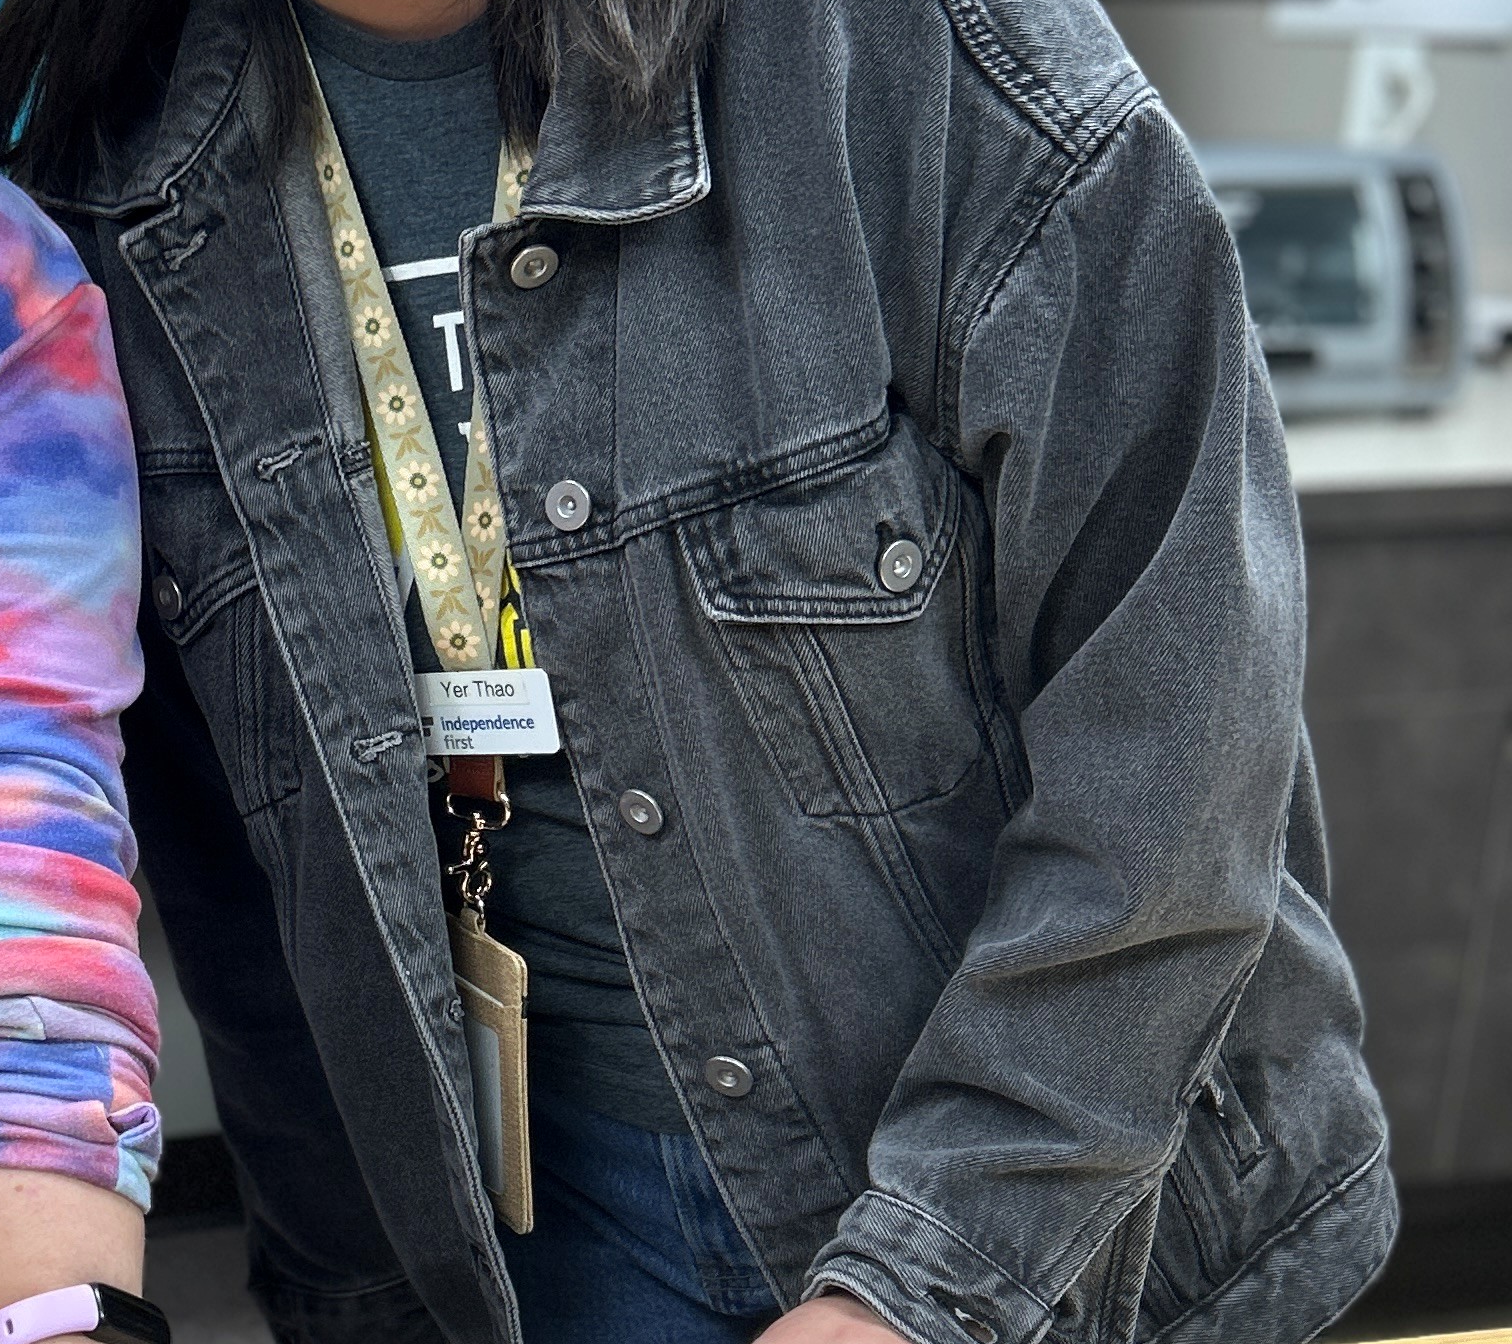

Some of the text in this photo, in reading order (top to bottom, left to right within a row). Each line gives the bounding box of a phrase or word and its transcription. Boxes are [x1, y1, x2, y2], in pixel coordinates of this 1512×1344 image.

[440, 680, 515, 698] Yer Thao
[440, 714, 535, 733] independence
[444, 735, 474, 749] first
